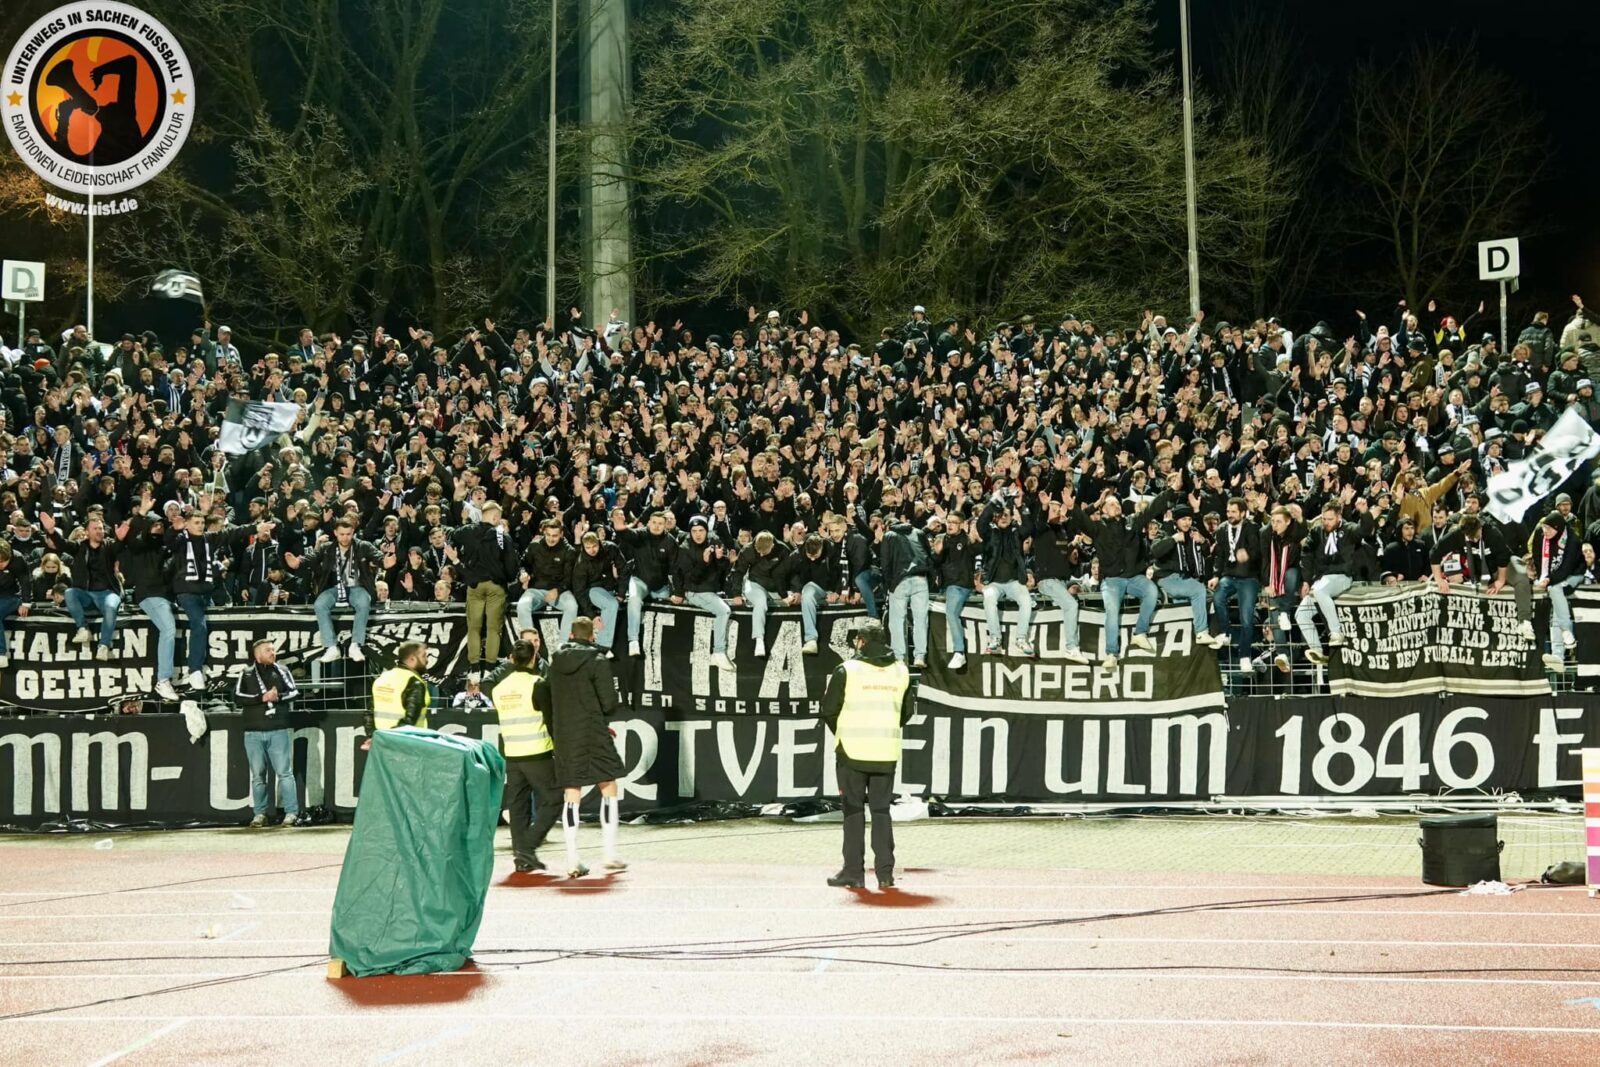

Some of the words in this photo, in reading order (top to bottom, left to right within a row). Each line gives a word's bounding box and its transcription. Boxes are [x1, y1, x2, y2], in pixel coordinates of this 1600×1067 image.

[1487, 246, 1510, 272] D
[11, 267, 35, 293] D
[1338, 606, 1353, 623] AS
[1357, 606, 1388, 623] ZIEL
[1393, 598, 1416, 618] DAS
[1421, 593, 1441, 612] IST
[1447, 596, 1480, 614] EINE
[1364, 622, 1380, 639] 90
[1388, 608, 1442, 637] MINUTEN
[1446, 610, 1485, 631] LANG
[1376, 629, 1429, 653] MINUTEN
[1460, 629, 1490, 649] RAD
[1341, 647, 1363, 667] UND
[1367, 654, 1390, 670] DIE
[1396, 649, 1421, 669] DEN
[15, 667, 154, 700] GEHEN
[981, 661, 1154, 699] IMPERO
[695, 698, 821, 714] SOCIETY
[1275, 706, 1495, 795] 1846
